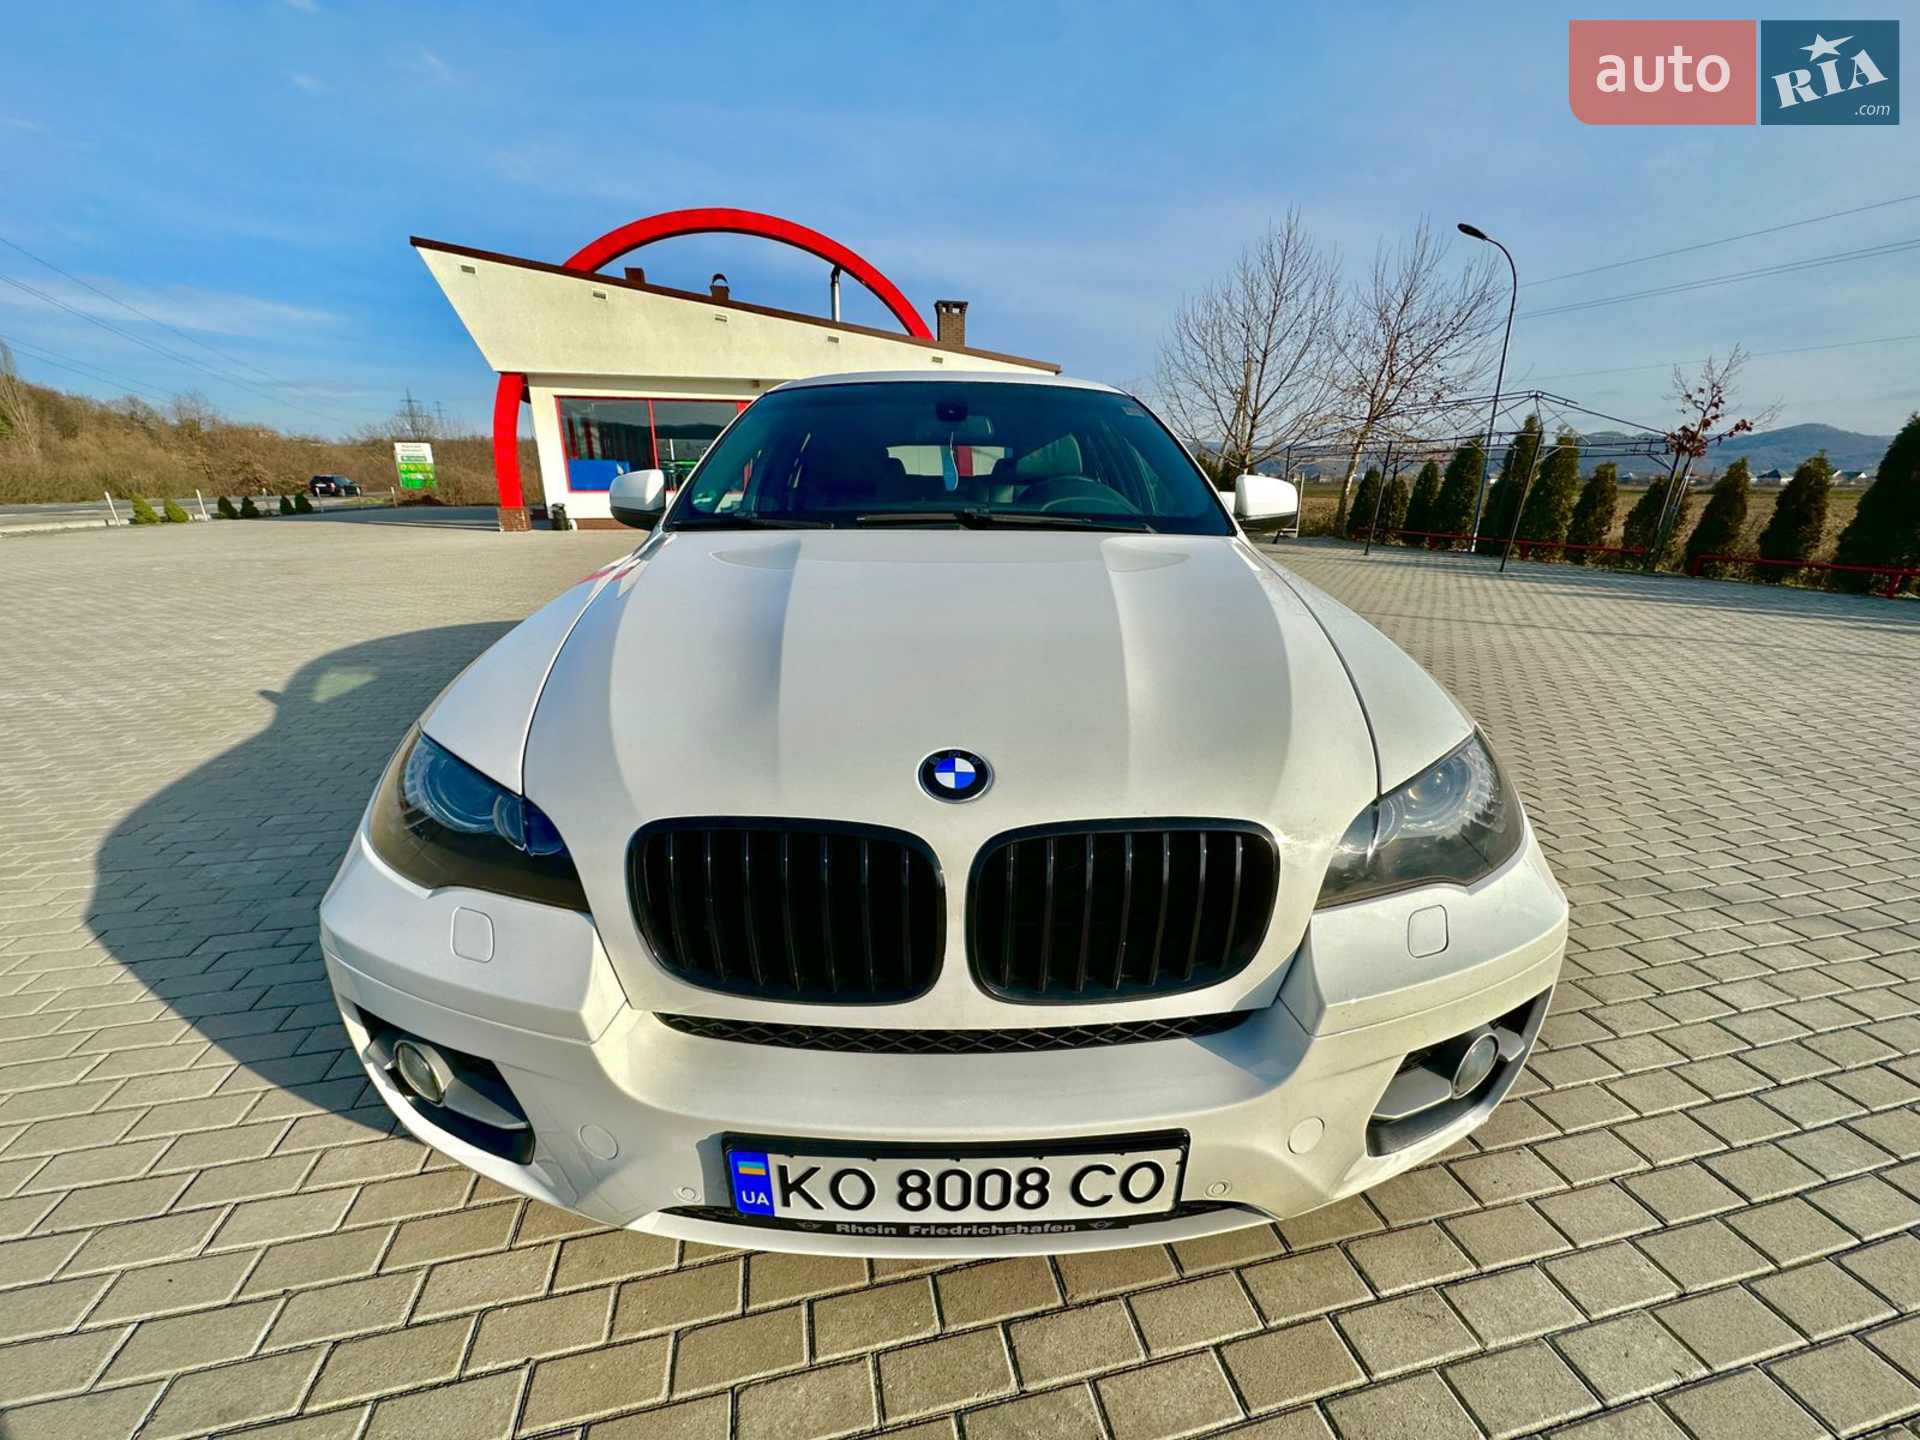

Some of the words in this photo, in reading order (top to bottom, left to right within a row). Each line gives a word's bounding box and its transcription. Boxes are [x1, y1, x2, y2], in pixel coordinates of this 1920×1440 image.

[928, 750, 981, 766] BMW
[777, 1164, 876, 1212] KO
[897, 1166, 1051, 1212] 8008
[1069, 1160, 1165, 1208] CO
[741, 1190, 770, 1206] UA
[835, 1223, 898, 1235] Rhein
[908, 1223, 1077, 1236] Friedrichshafen
